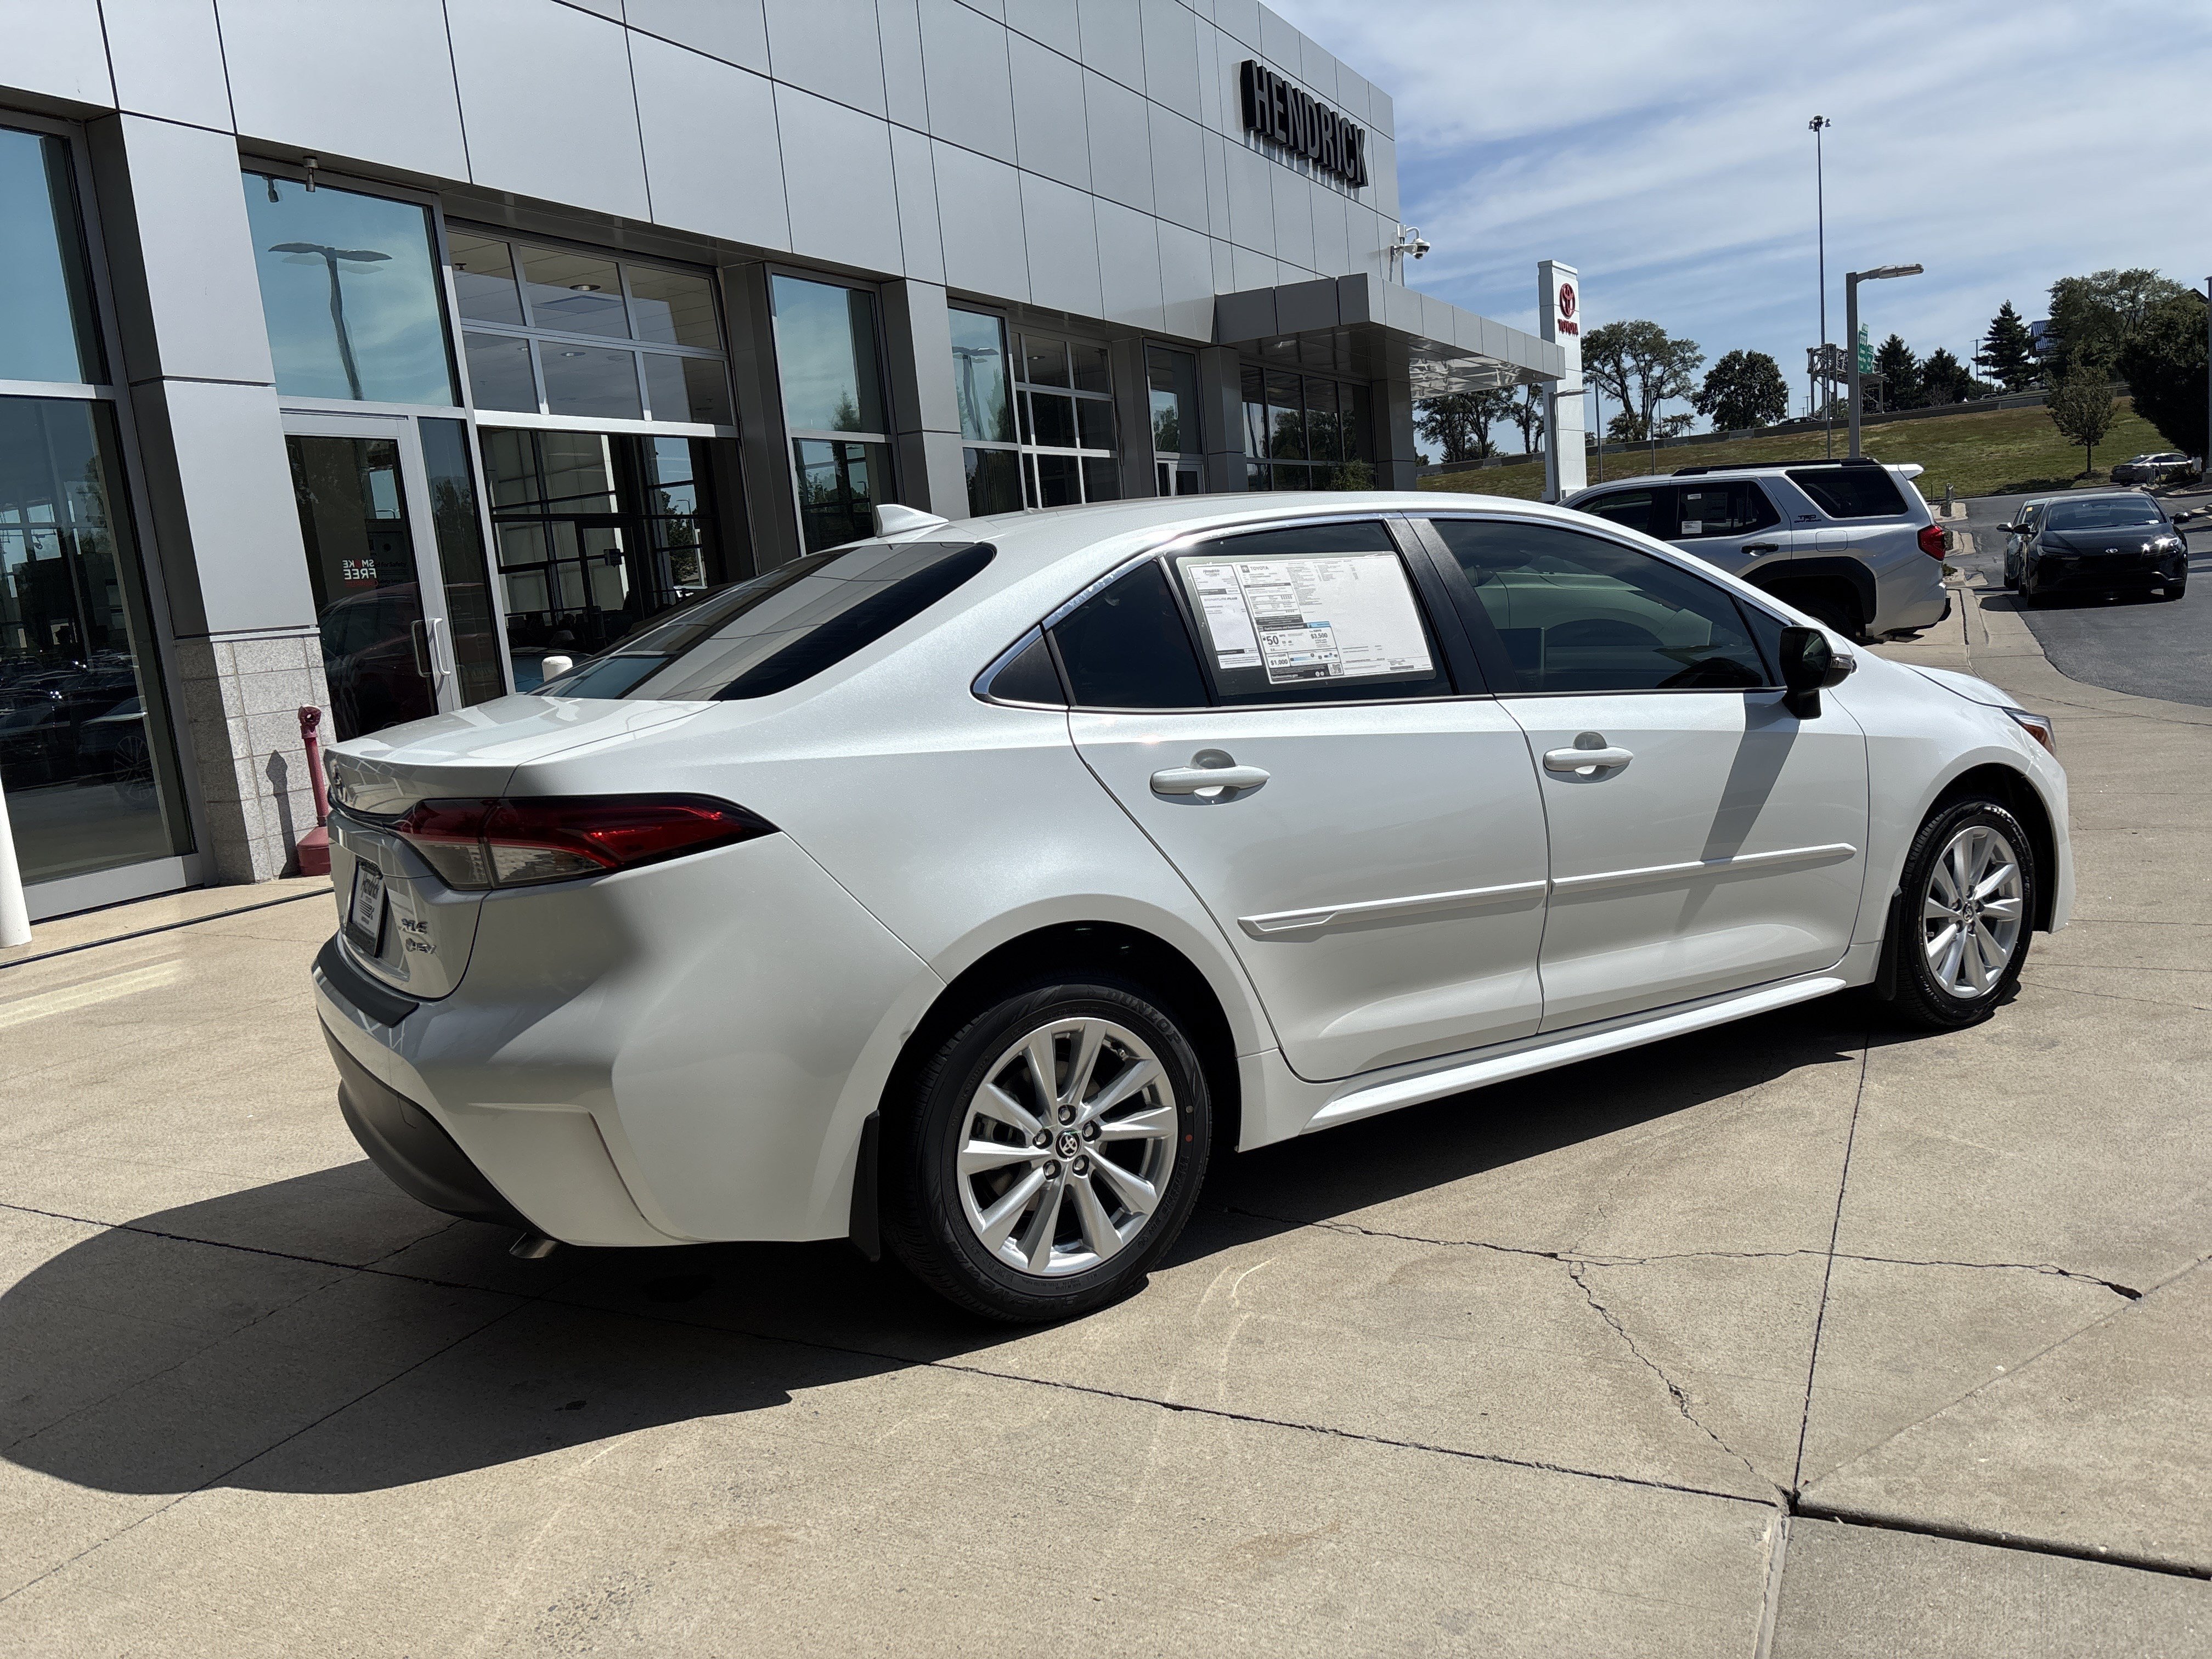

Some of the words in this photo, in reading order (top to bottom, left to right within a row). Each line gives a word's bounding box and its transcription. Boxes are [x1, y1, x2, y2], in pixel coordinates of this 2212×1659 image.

[1240, 59, 1369, 188] HENDRICK
[1558, 318, 1578, 337] TOYOTA
[1266, 635, 1279, 645] 50
[1104, 989, 1182, 1045] DUNLOP
